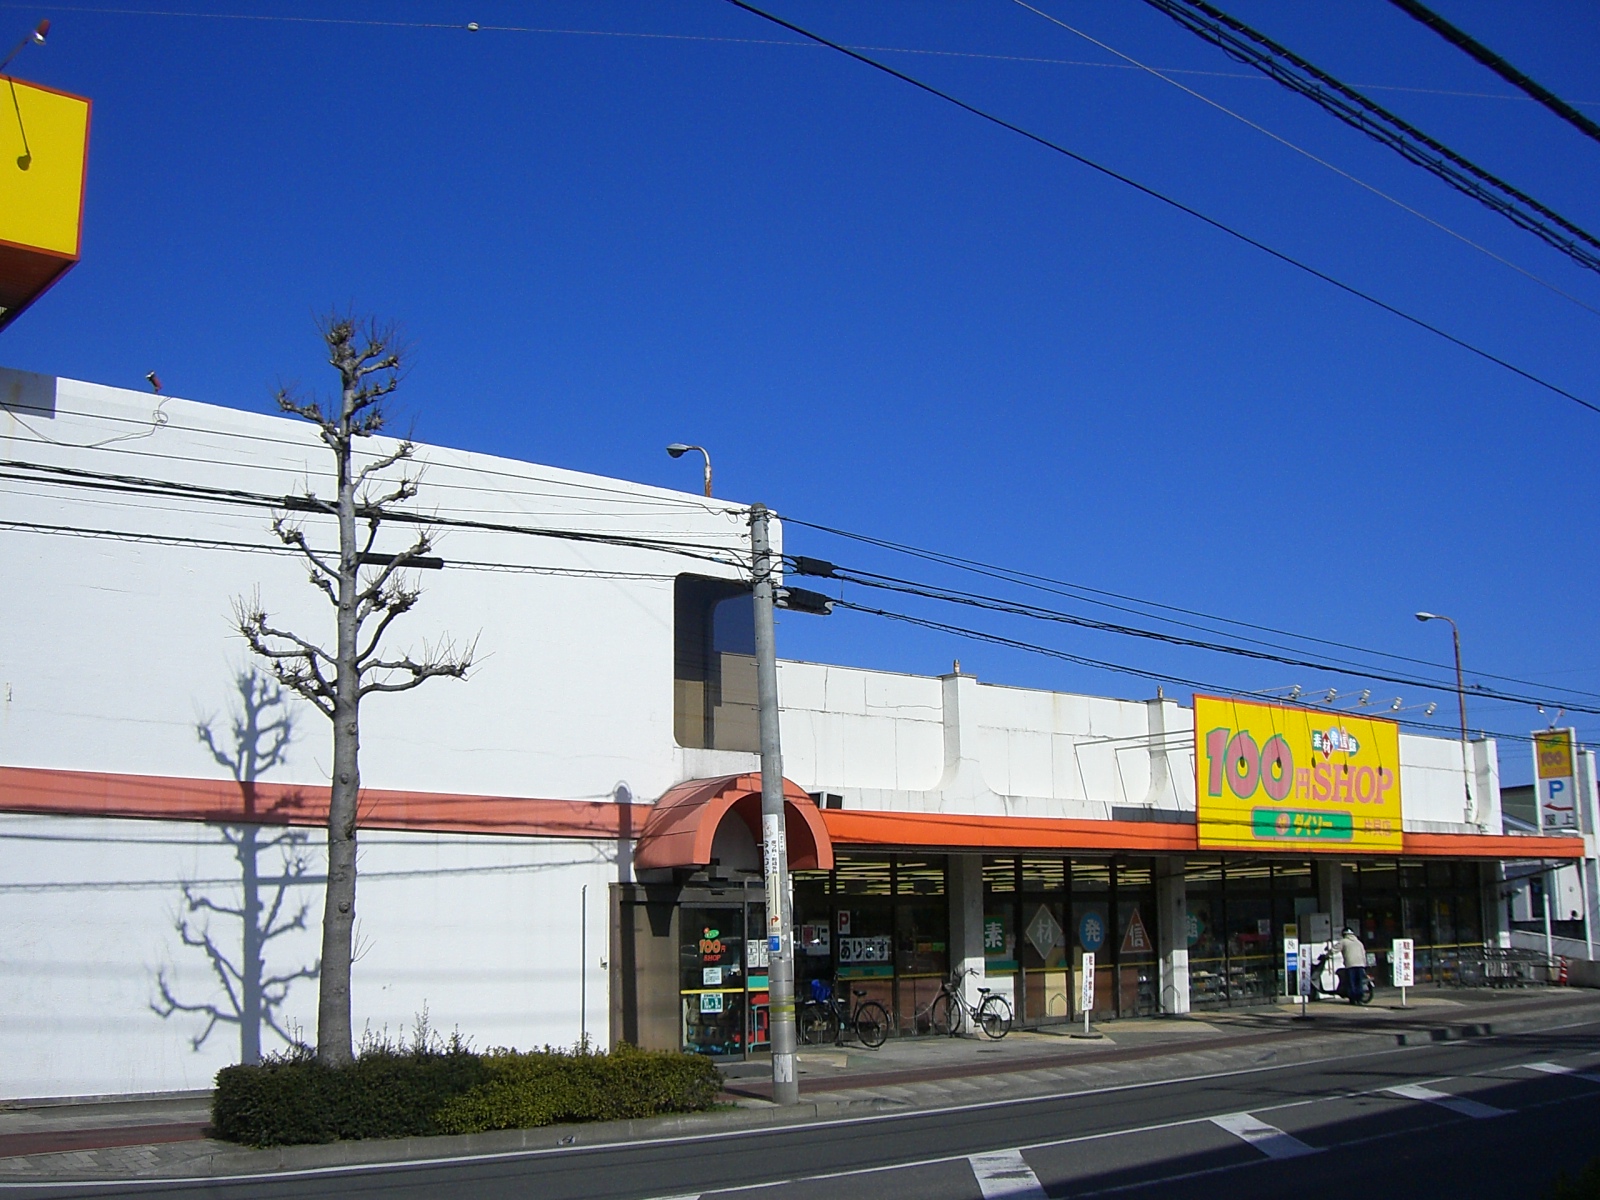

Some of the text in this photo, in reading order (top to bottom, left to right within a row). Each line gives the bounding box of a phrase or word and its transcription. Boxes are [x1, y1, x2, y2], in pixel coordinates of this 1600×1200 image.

[1549, 780, 1564, 799] P
[840, 912, 849, 931] P
[985, 921, 1003, 948] 素
[1037, 918, 1054, 944] 材
[1085, 919, 1101, 943] 発
[1129, 923, 1144, 948] 信
[703, 954, 722, 962] SHOP
[841, 939, 887, 960] あります
